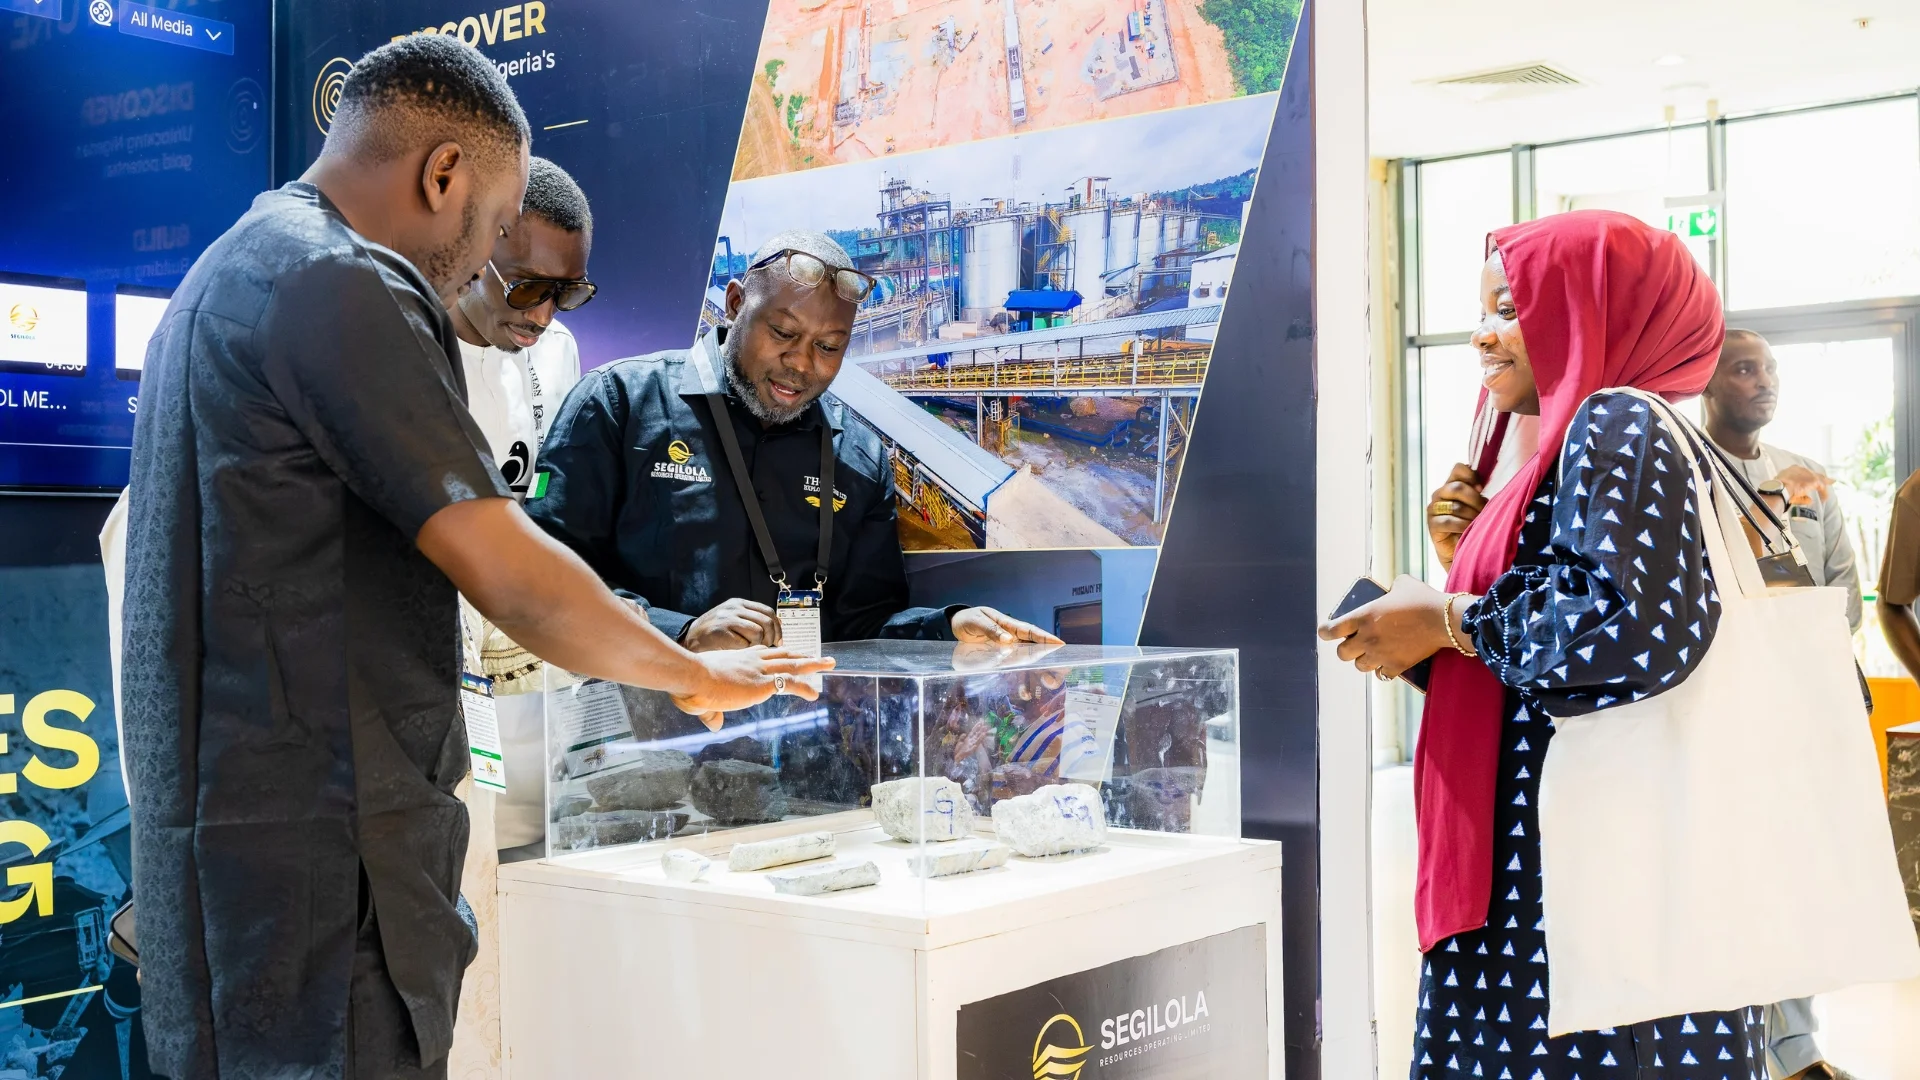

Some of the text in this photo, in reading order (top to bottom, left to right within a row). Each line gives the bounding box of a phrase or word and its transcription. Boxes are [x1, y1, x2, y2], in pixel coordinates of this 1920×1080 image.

[130, 11, 193, 37] All Media
[391, 1, 546, 50] OVER
[654, 462, 707, 477] SEGILOLA
[1101, 990, 1209, 1050] SEGILOLA
[1100, 1023, 1211, 1067] RESOURCES OPERATING LIMITED
